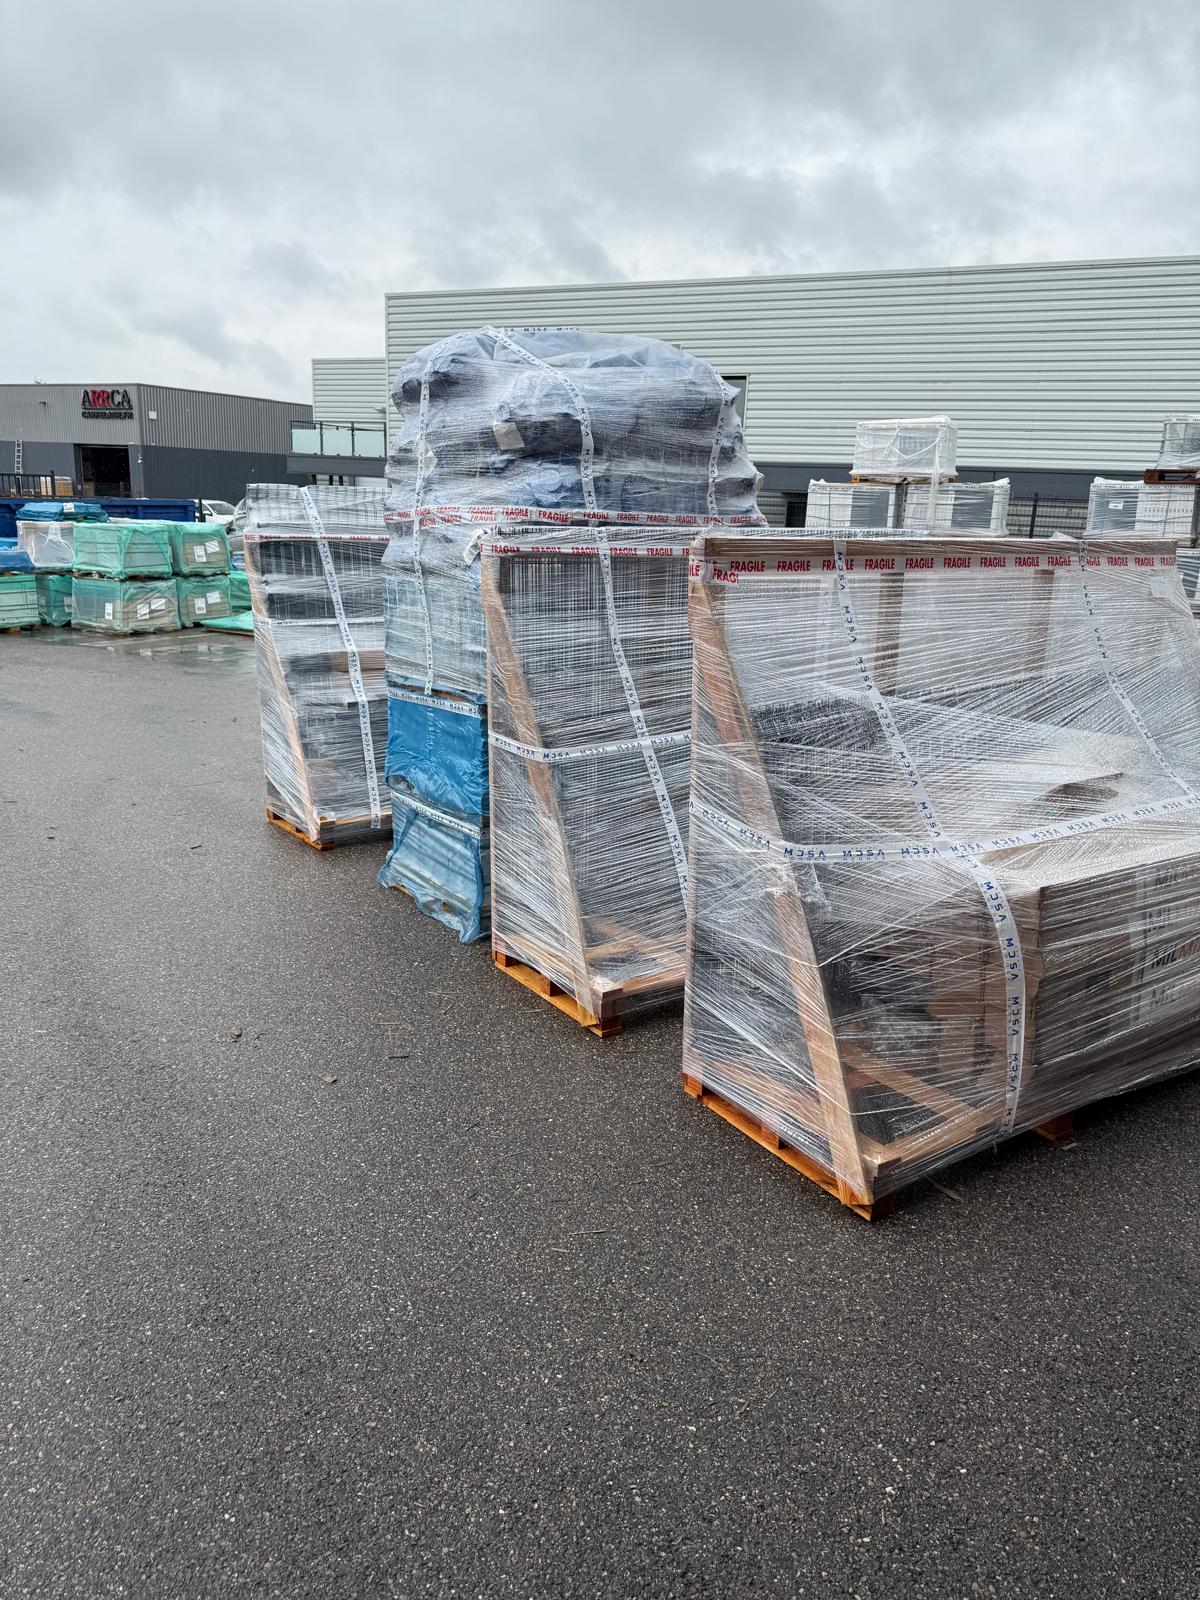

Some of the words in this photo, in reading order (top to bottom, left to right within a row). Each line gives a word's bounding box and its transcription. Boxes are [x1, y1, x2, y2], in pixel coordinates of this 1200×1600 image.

[81, 389, 133, 407] ARRCA
[538, 510, 569, 523] FRAGILE
[675, 515, 697, 524] FRAGILE
[610, 547, 638, 556] FRAGILE
[646, 547, 673, 557] FRAGILE
[729, 560, 766, 573] FRAGILE
[777, 559, 811, 572] FRAGILE
[864, 558, 896, 570] FRAGILE
[905, 557, 934, 569] FRAGILE
[943, 556, 971, 568] FRAGILE
[980, 556, 1007, 568] FRAGILE
[1015, 556, 1040, 567] FRAGILE
[1047, 556, 1072, 567] FRAGILE
[1107, 556, 1129, 567] FRAGILE
[1135, 556, 1155, 567] FRAGILE
[843, 605, 858, 643] MJSA
[857, 656, 873, 692] MJSA
[875, 702, 896, 738] MJSA
[898, 751, 919, 787] MJSA
[920, 801, 941, 838] MJSA
[784, 847, 826, 858] MJSA
[842, 849, 885, 857] MJSA
[900, 847, 940, 855] MJSA
[950, 843, 986, 853] MJSA
[992, 836, 1024, 848] MJSA
[1031, 827, 1062, 840] MJSA
[1067, 820, 1096, 833] MJSA
[984, 880, 1007, 922] MJSA
[1005, 937, 1019, 981] MJSA
[1011, 996, 1020, 1036] MJSA
[1009, 1053, 1019, 1092] MJSA
